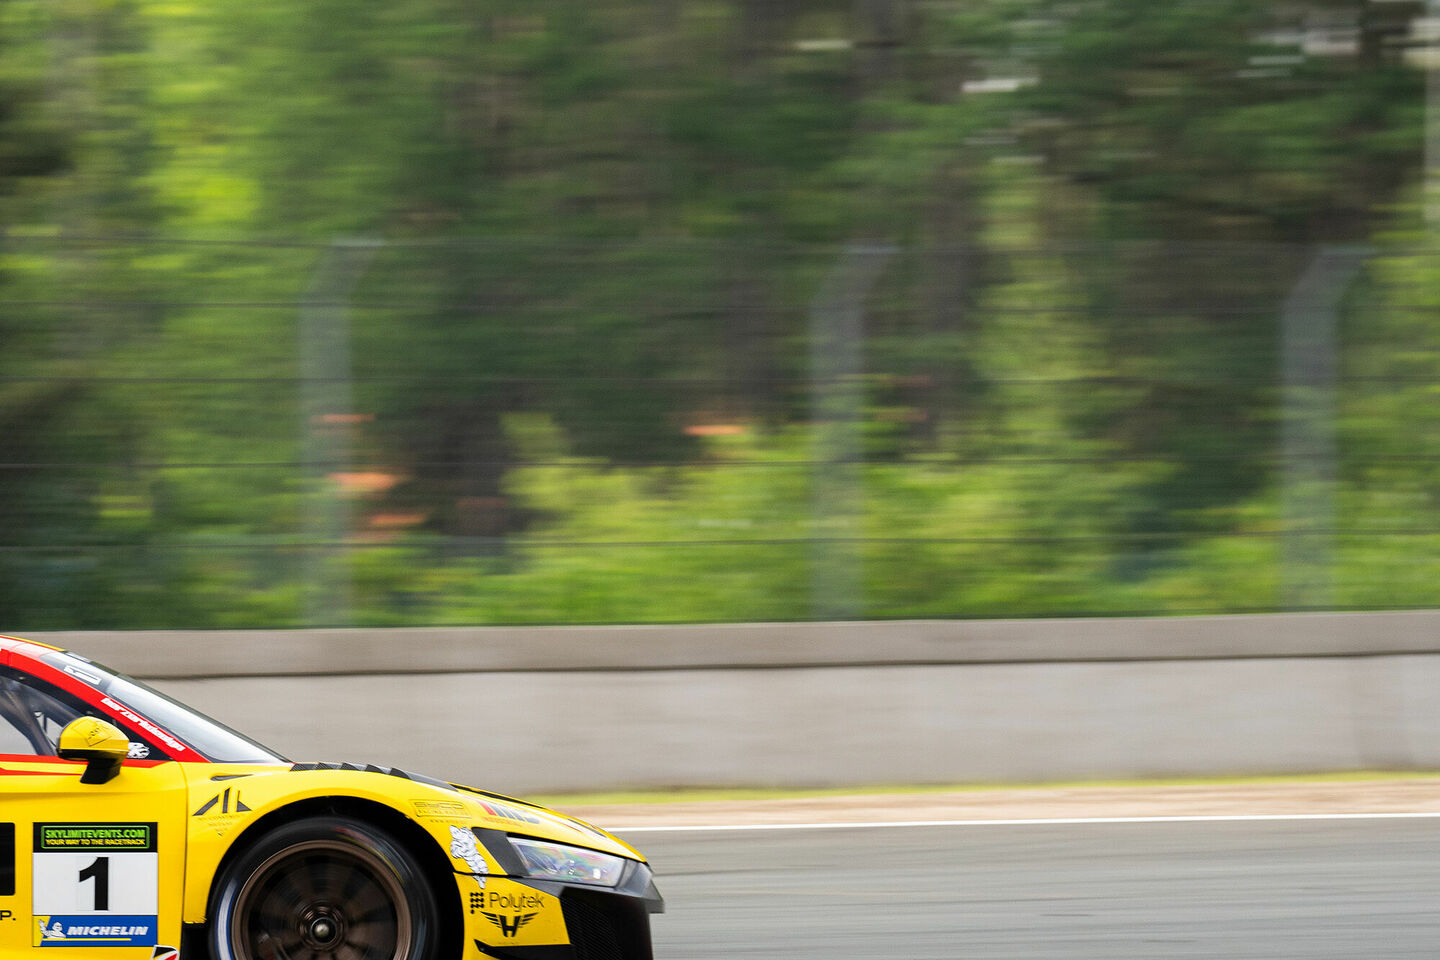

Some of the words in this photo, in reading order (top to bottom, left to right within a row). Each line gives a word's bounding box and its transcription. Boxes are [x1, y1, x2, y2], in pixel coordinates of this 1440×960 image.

[45, 829, 146, 838] SKYLIMITEVENTS.COM
[46, 838, 65, 846] YOUR
[66, 838, 80, 846] WAY
[81, 838, 90, 846] TO
[91, 838, 104, 846] THE
[105, 838, 145, 846] RACETRACK
[78, 856, 109, 911] 1
[489, 892, 545, 912] Polytek
[67, 926, 149, 936] MICHELIN
